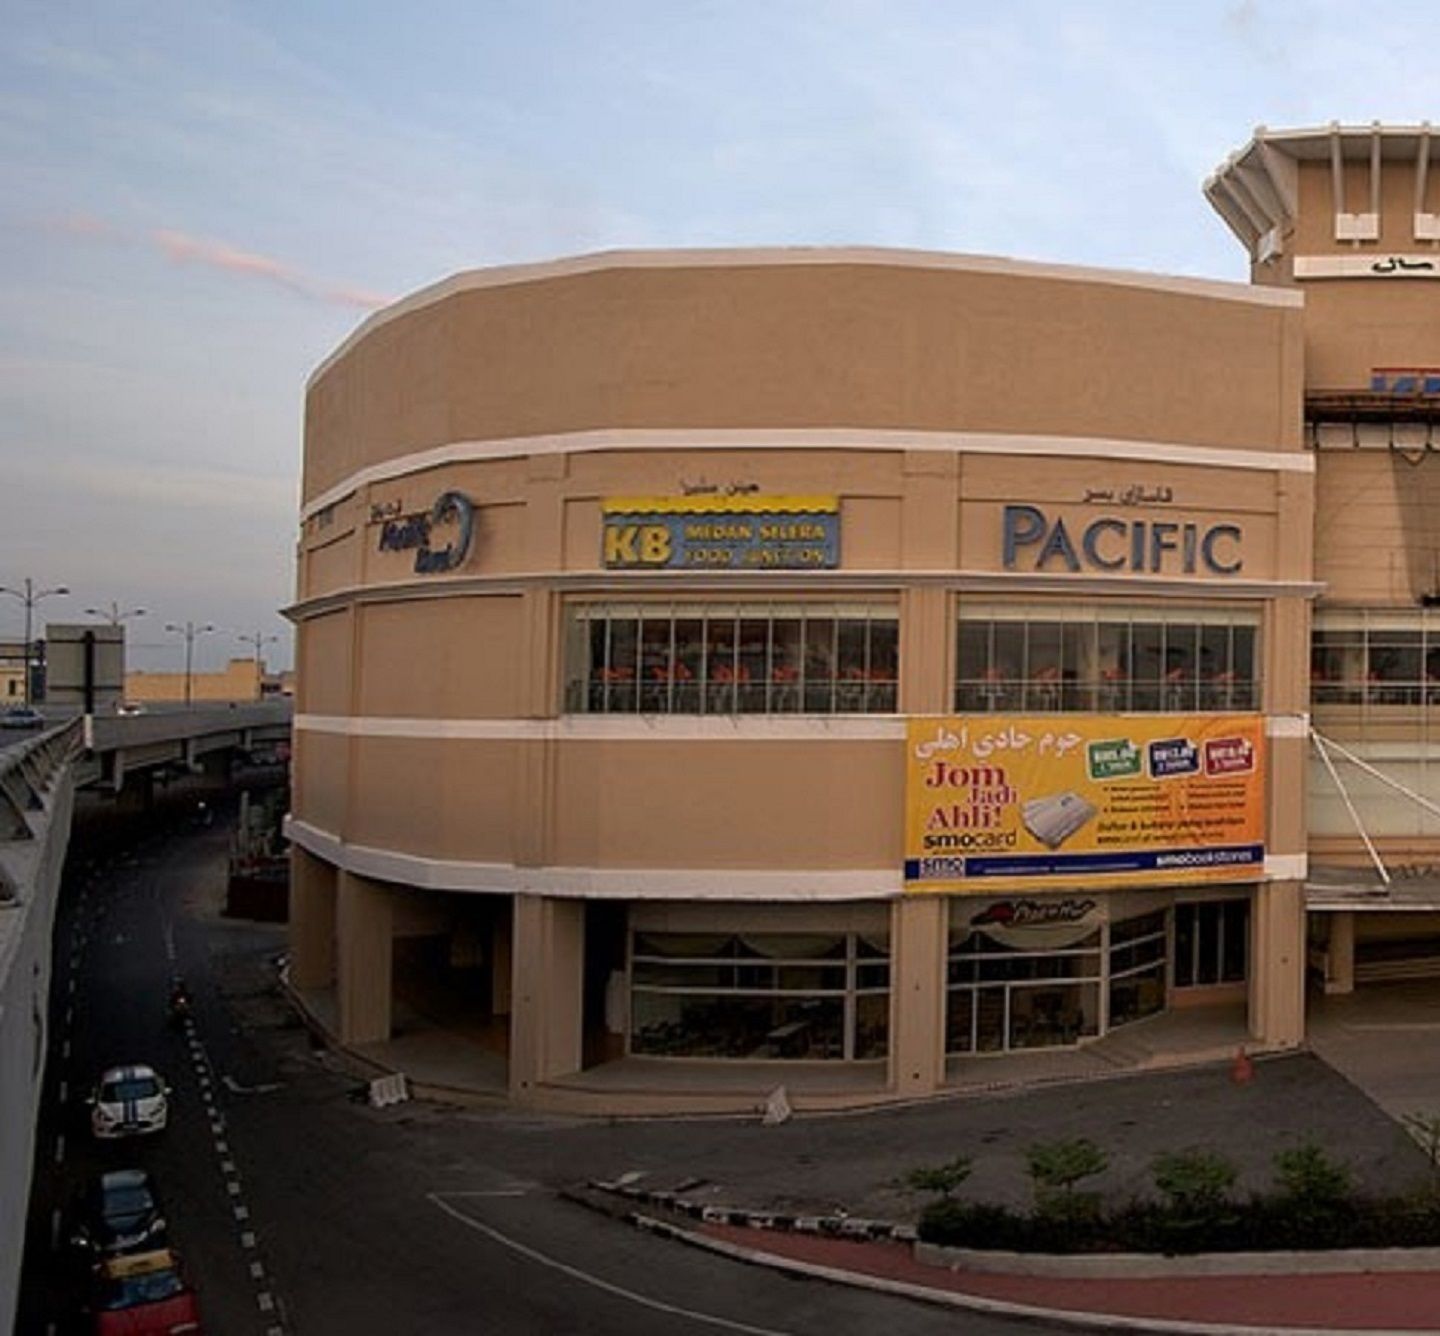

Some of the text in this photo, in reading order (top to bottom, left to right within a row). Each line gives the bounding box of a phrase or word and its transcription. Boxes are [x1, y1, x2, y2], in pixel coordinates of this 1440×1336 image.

[604, 525, 672, 562] KB
[684, 524, 825, 541] MEDAN SELERA
[1003, 505, 1243, 574] PACIFIC
[926, 762, 1005, 788] Jom
[967, 785, 1017, 804] Jadi
[926, 805, 1001, 829] Ahli!
[923, 827, 1017, 850] smocard
[1156, 851, 1252, 867] smobookstores
